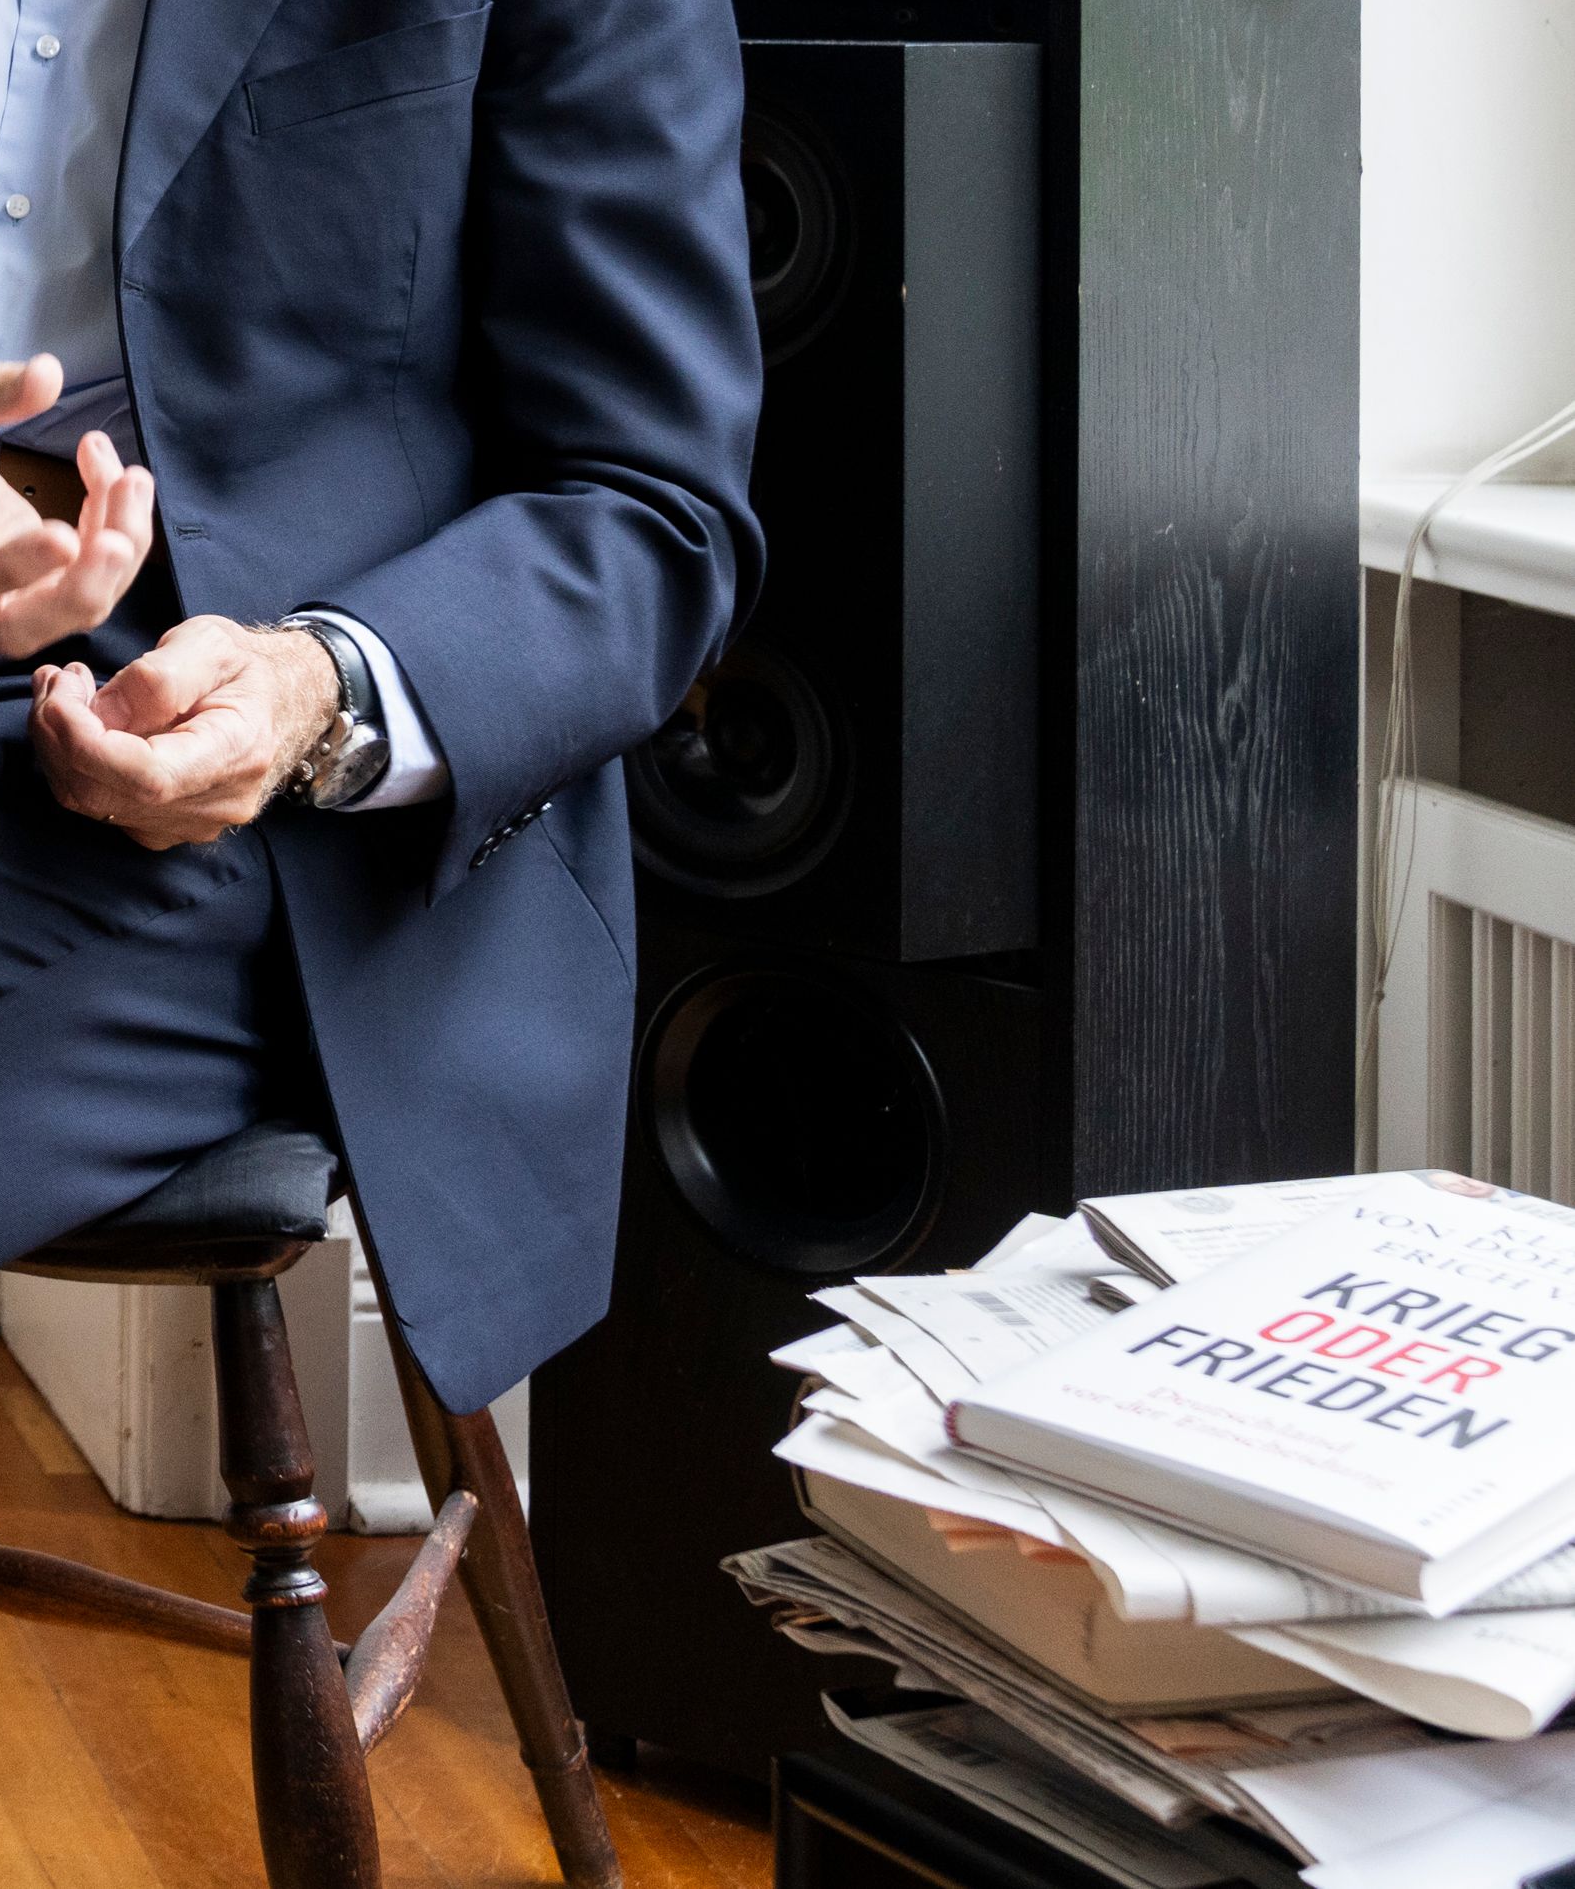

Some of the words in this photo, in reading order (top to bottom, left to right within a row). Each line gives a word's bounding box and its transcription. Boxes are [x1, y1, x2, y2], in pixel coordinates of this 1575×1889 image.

[1354, 1206, 1446, 1240] VON
[1372, 1241, 1532, 1292] ERICH
[1257, 1309, 1505, 1396] ODER
[1302, 1270, 1575, 1364] KRIEG
[1124, 1322, 1512, 1451] FRIEDEN
